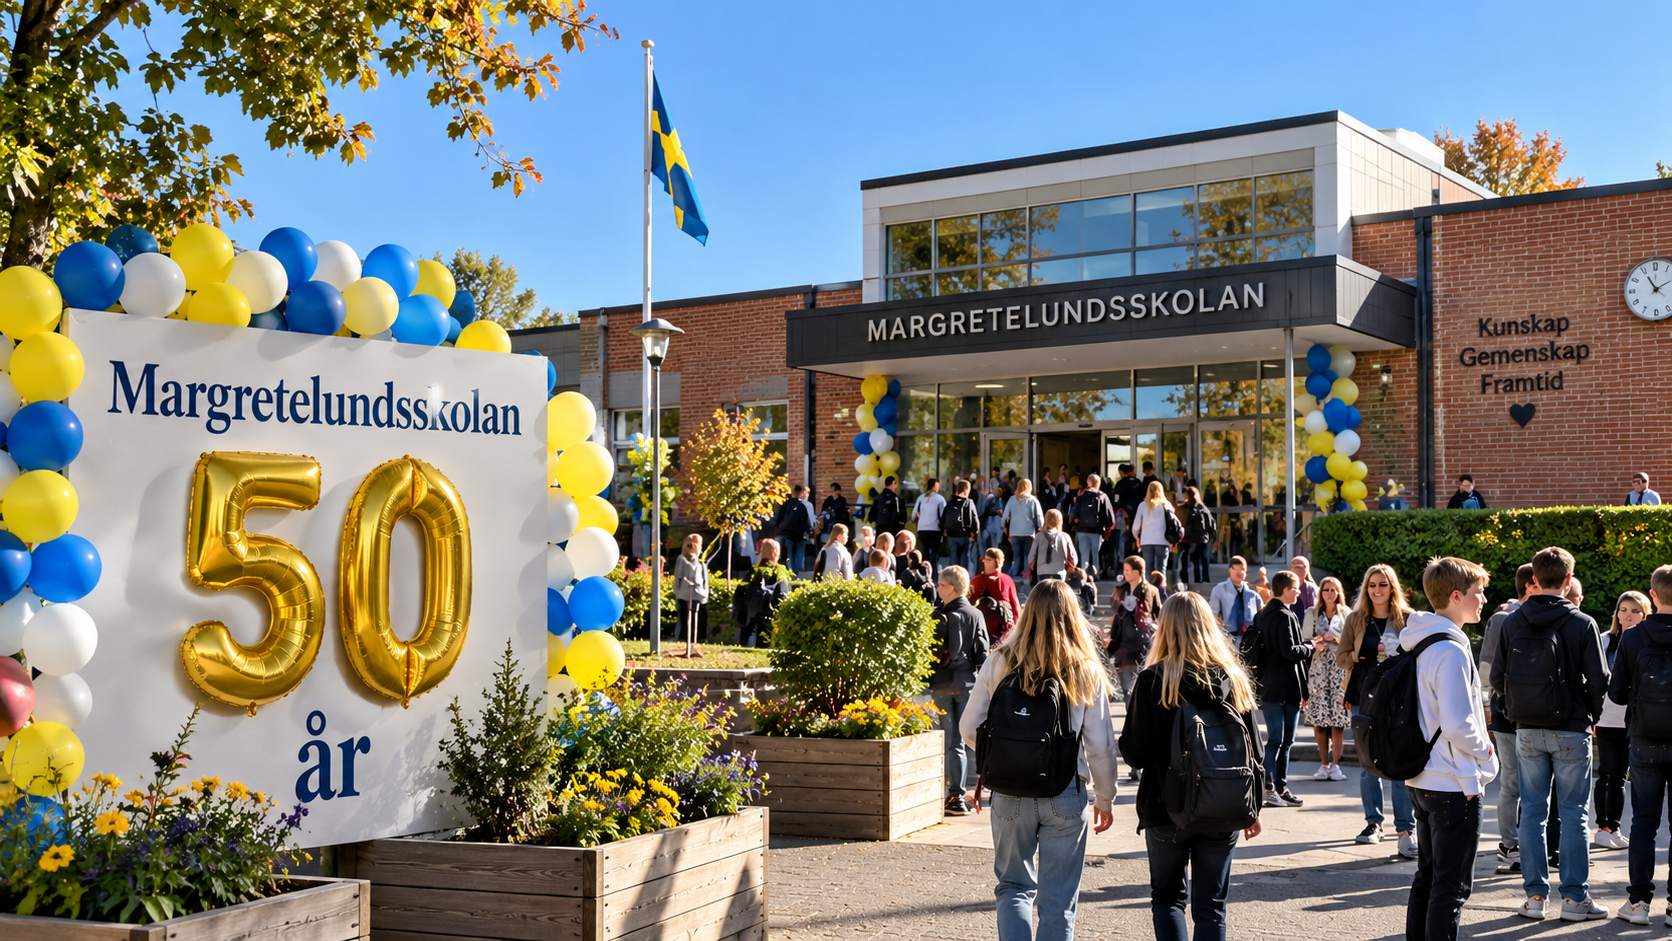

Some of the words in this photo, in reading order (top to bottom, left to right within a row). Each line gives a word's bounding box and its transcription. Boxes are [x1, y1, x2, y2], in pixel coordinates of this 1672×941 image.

[867, 282, 1265, 342] MARGRETELUNDSSKOLAN
[1478, 314, 1570, 338] Kunskap
[1459, 341, 1590, 367] Gemenskap
[1481, 370, 1564, 394] Framtid
[107, 360, 522, 435] Margretelundsskolan
[179, 450, 473, 716] 50
[295, 710, 371, 803] år
